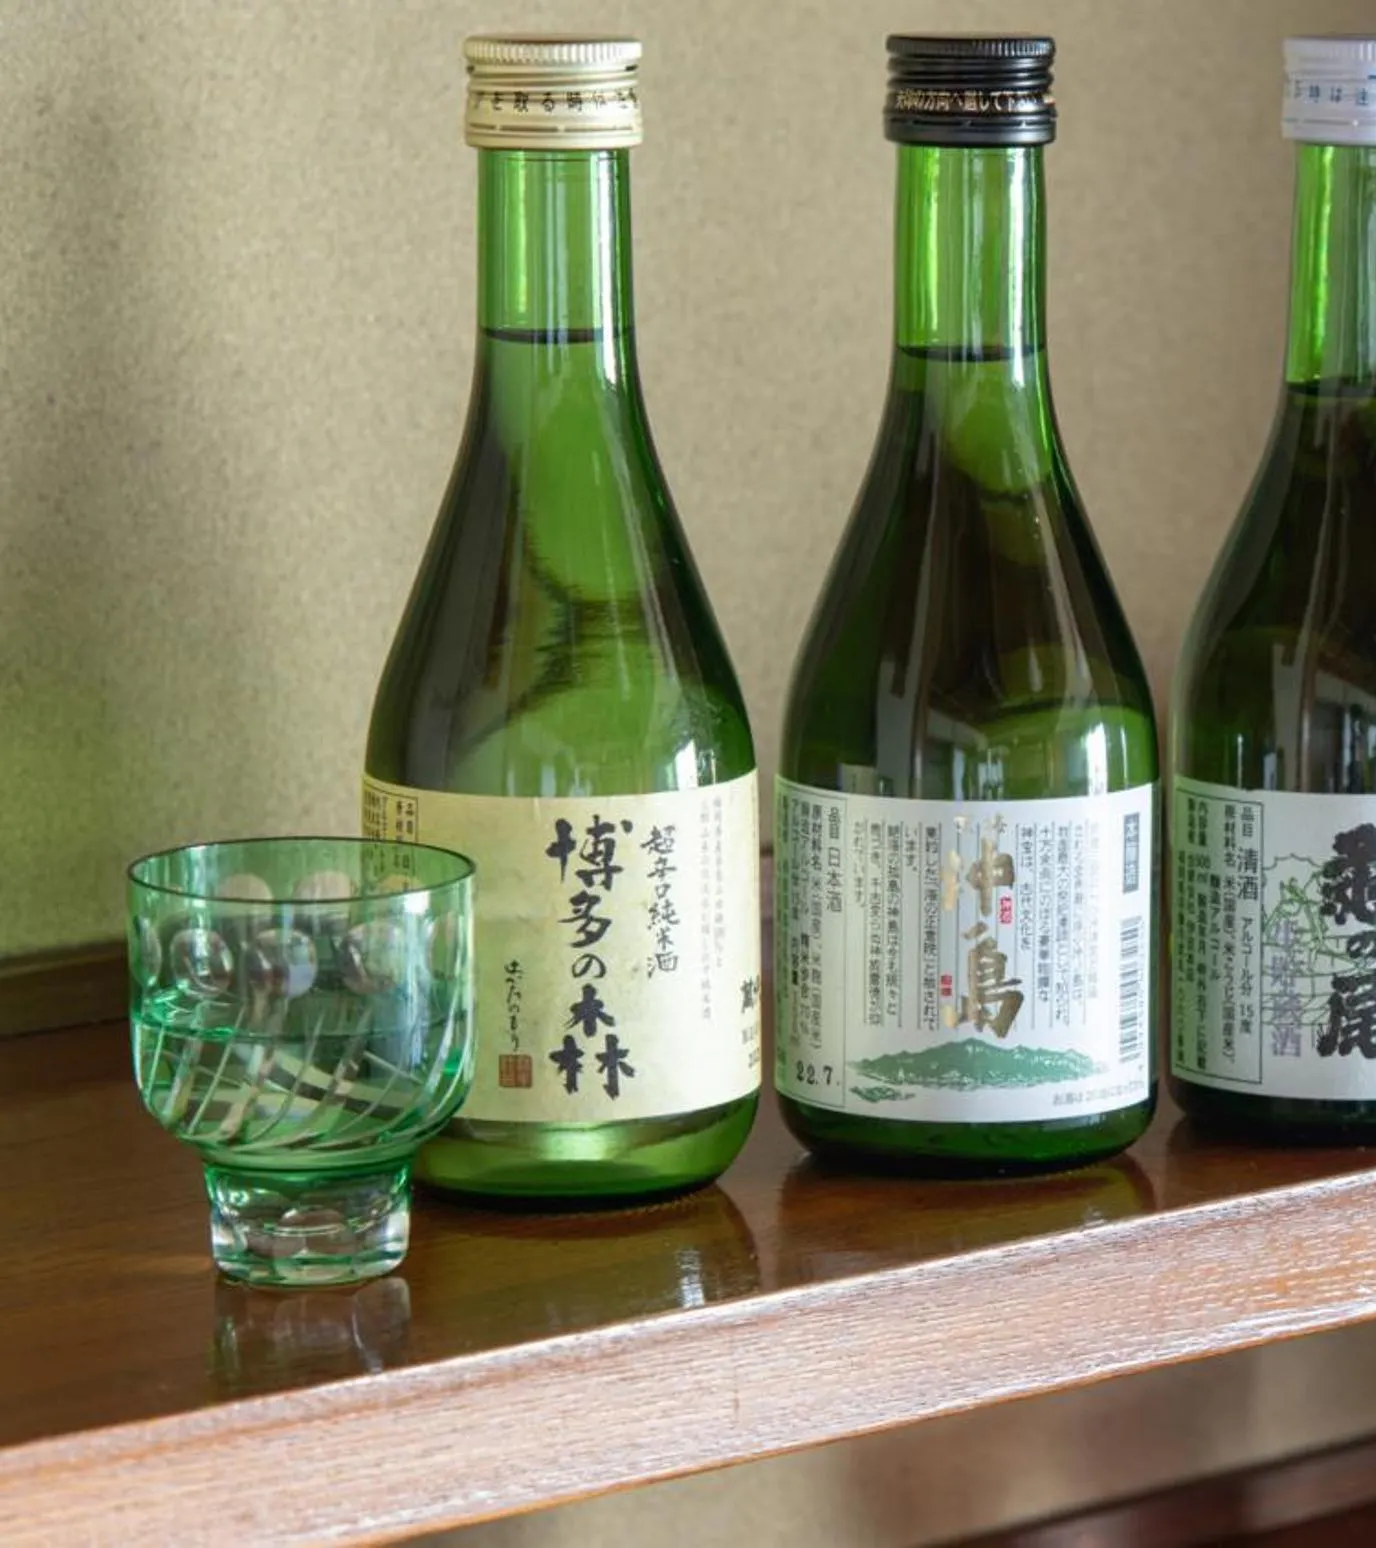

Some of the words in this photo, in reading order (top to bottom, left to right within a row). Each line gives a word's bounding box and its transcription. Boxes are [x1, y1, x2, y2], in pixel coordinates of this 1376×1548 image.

[640, 824, 681, 979] 超辛口純米酒
[827, 846, 842, 913] 日本酒
[1237, 847, 1259, 901] 清酒
